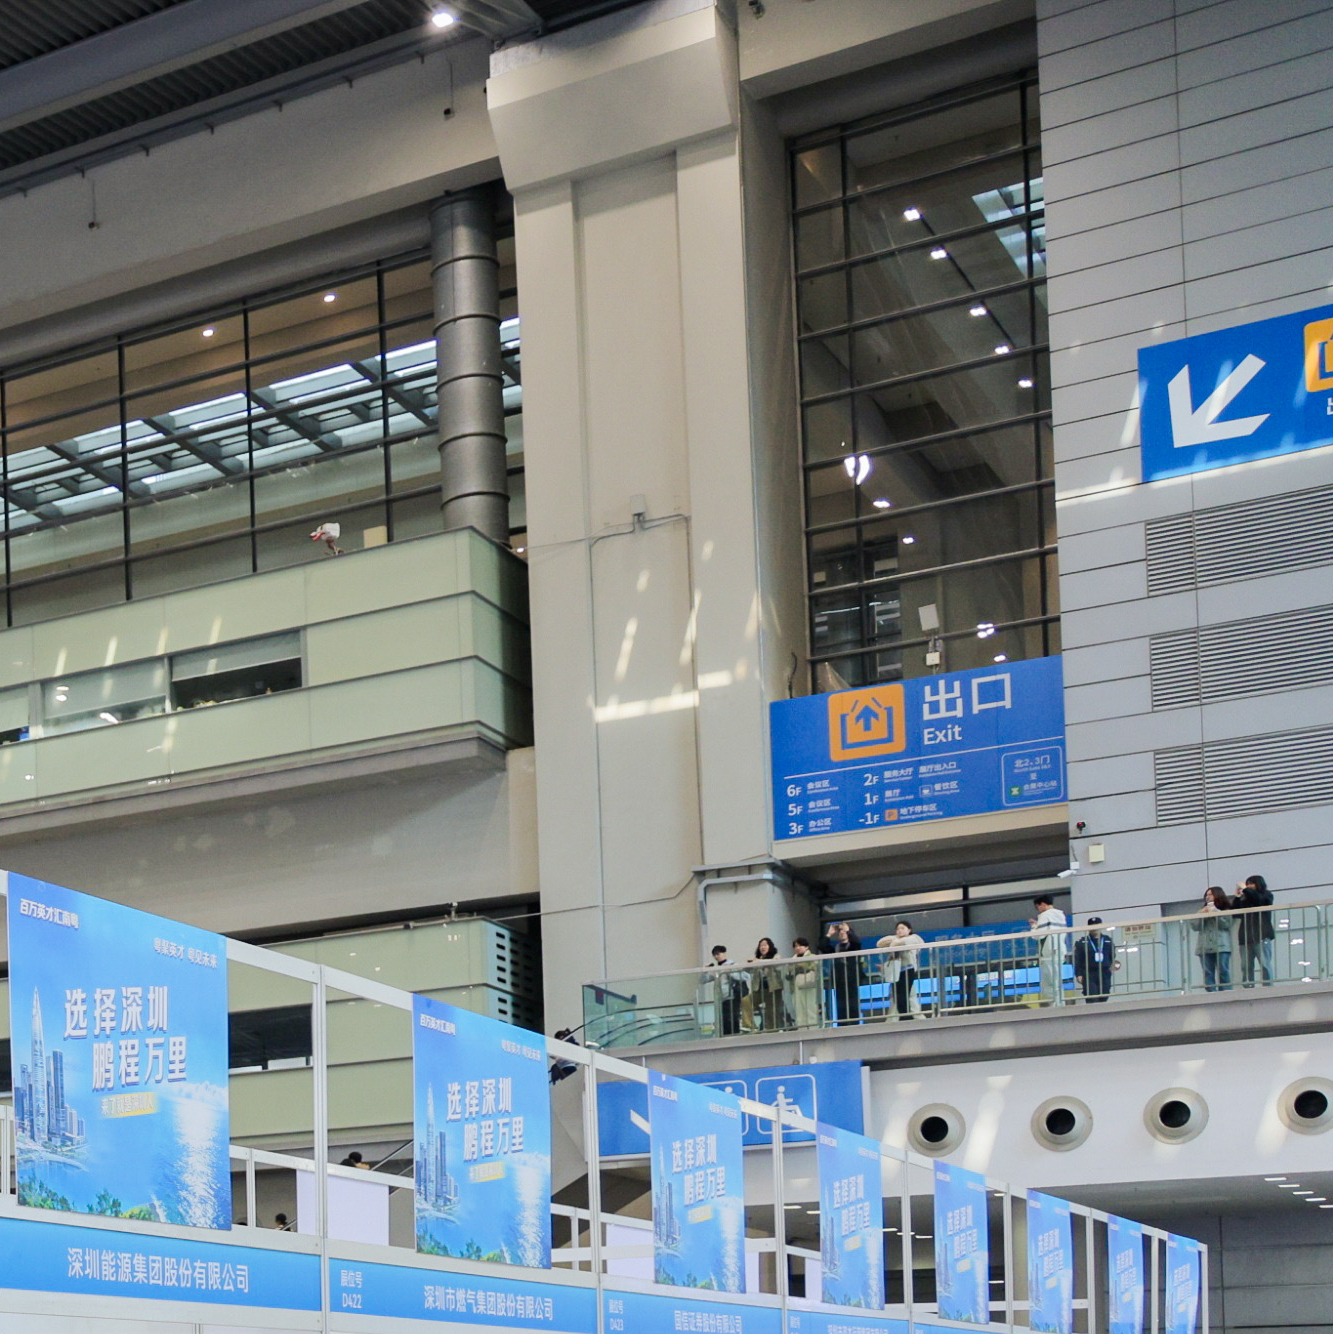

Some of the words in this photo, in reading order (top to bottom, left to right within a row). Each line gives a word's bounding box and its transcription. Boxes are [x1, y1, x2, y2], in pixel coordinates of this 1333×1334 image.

[922, 673, 1013, 722] 出口
[923, 724, 963, 746] Exit
[863, 773, 879, 786] 2F
[787, 784, 802, 797] 6F
[864, 793, 879, 806] 1F
[788, 803, 803, 816] 5F
[858, 812, 880, 825] -1F
[788, 822, 804, 835] 3F
[63, 985, 169, 1041] 选择深圳
[92, 1035, 188, 1091] 鹏程万里
[446, 1077, 513, 1122] 选择深圳
[67, 1247, 250, 1293] 深圳能源集团股份有限公司
[342, 1293, 362, 1309] D422
[424, 1285, 553, 1321] 深圳市燃气集团股份有限公司
